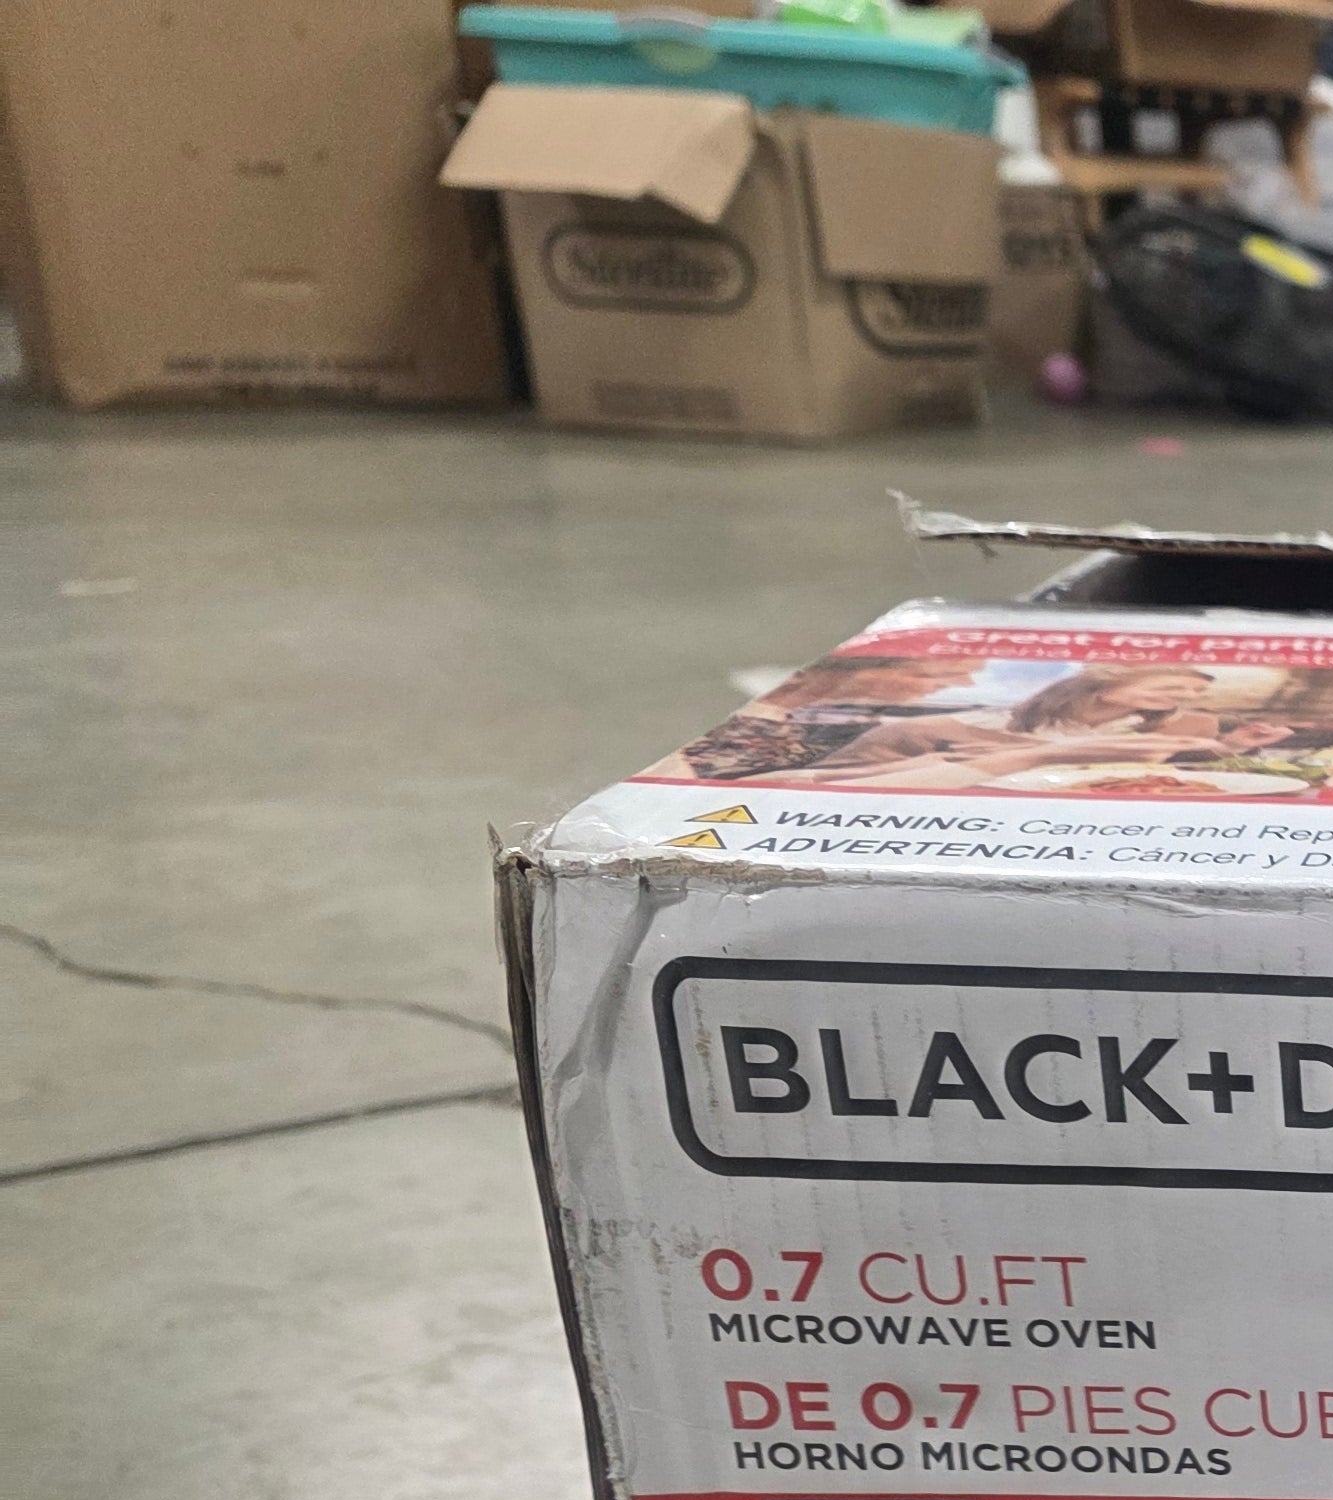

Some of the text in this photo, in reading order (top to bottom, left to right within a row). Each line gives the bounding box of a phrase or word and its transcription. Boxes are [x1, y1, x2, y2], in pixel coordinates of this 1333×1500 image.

[928, 643, 1073, 658] Buena
[1086, 648, 1160, 663] por
[1181, 648, 1218, 663] la
[948, 631, 1093, 646] Great
[1111, 633, 1189, 650] for
[776, 811, 1005, 833] WARNING:
[1019, 819, 1164, 837] Cancer
[1171, 823, 1248, 839] and
[741, 836, 1092, 861] ADVERTENCIA:
[1109, 847, 1255, 865] Cáncer
[1262, 853, 1288, 869] y
[700, 1247, 1087, 1308] 0.7 CU.FT
[708, 1312, 1158, 1350] MICROWAVE OVEN
[725, 1380, 836, 1432] DE
[861, 1381, 981, 1431] 0.7
[1011, 1383, 1177, 1437] PIES
[733, 1441, 1233, 1476] HORNO MICROONDAS
